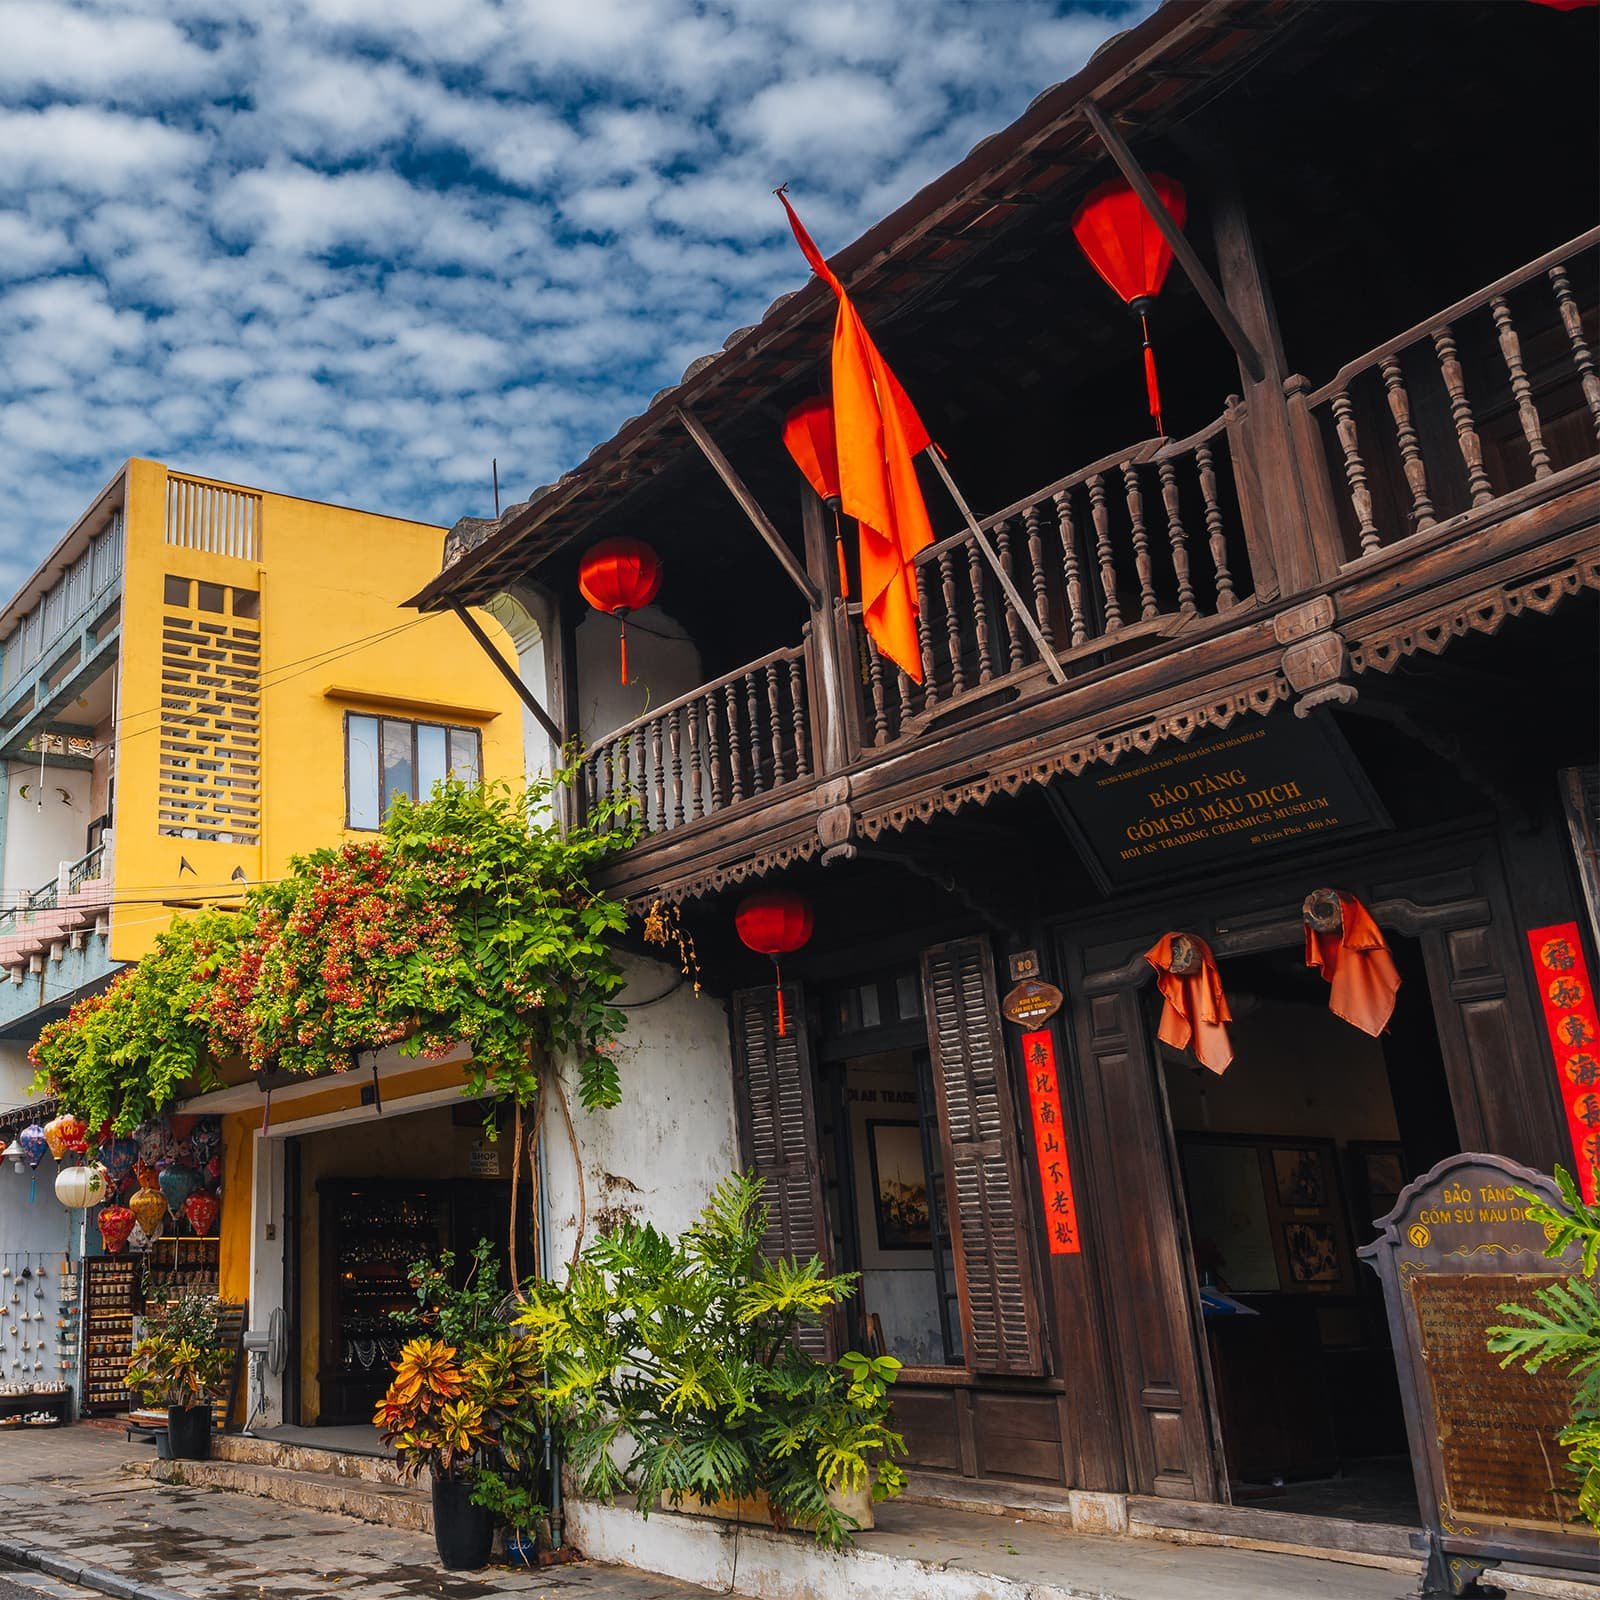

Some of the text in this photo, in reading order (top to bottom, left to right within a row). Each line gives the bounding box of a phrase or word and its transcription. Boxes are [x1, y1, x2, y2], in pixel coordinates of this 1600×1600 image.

[1148, 768, 1248, 808] BẢO TÀNG
[1126, 781, 1303, 841] GỐM SỨ MẬU DỊCH
[1143, 843, 1157, 854] AN
[1158, 829, 1209, 849] TRADING
[1211, 812, 1271, 836] CERAMICS
[1274, 797, 1328, 819] MUSEUM
[1420, 1203, 1451, 1224] GỐM
[1443, 1183, 1515, 1204] BẢO TÀNG
